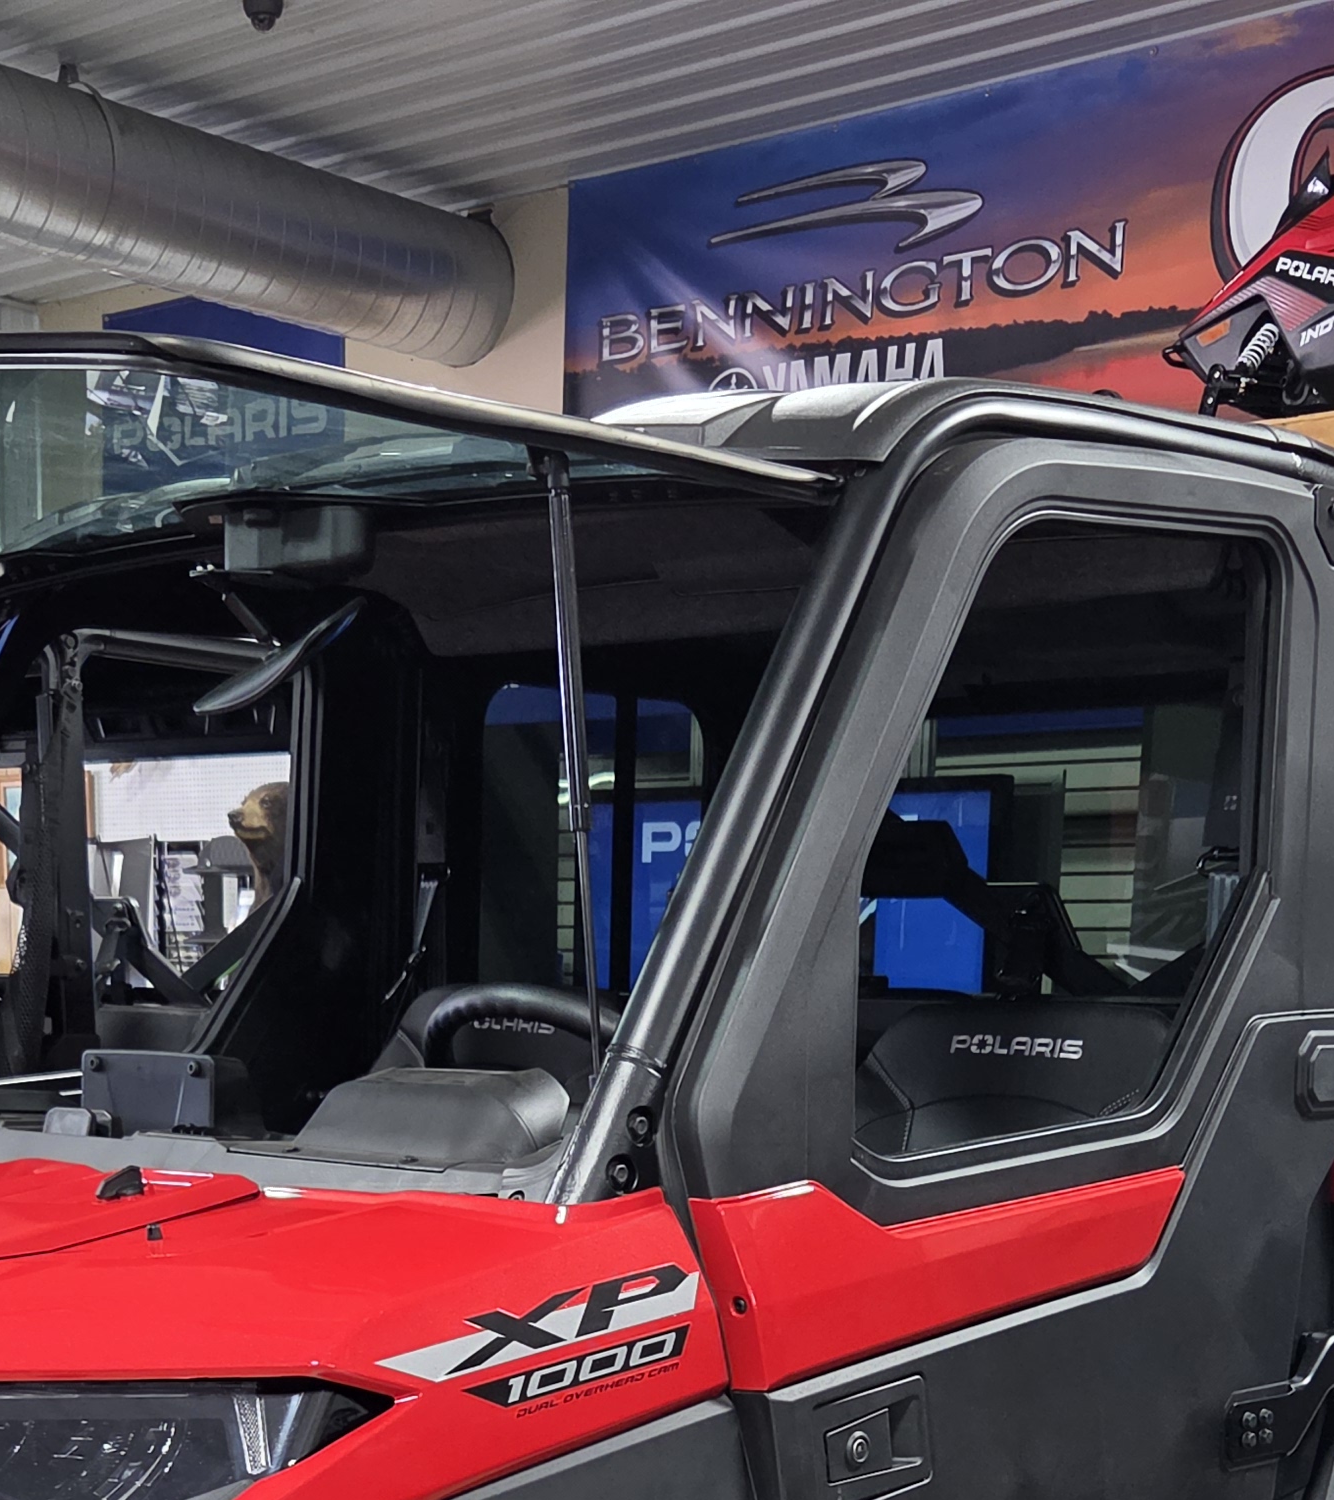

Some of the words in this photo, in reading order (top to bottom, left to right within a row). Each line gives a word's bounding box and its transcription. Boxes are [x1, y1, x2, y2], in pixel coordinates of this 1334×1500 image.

[599, 220, 1127, 363] BENNINGTON
[763, 337, 946, 393] YAMAHA
[112, 398, 329, 455] POLARIS
[949, 1034, 1084, 1060] POLARIS
[442, 1262, 690, 1376] XP
[507, 1331, 677, 1404] 1000
[515, 1401, 559, 1419] DUAL
[562, 1372, 645, 1404] OVERHEAD
[647, 1361, 680, 1378] CAM
